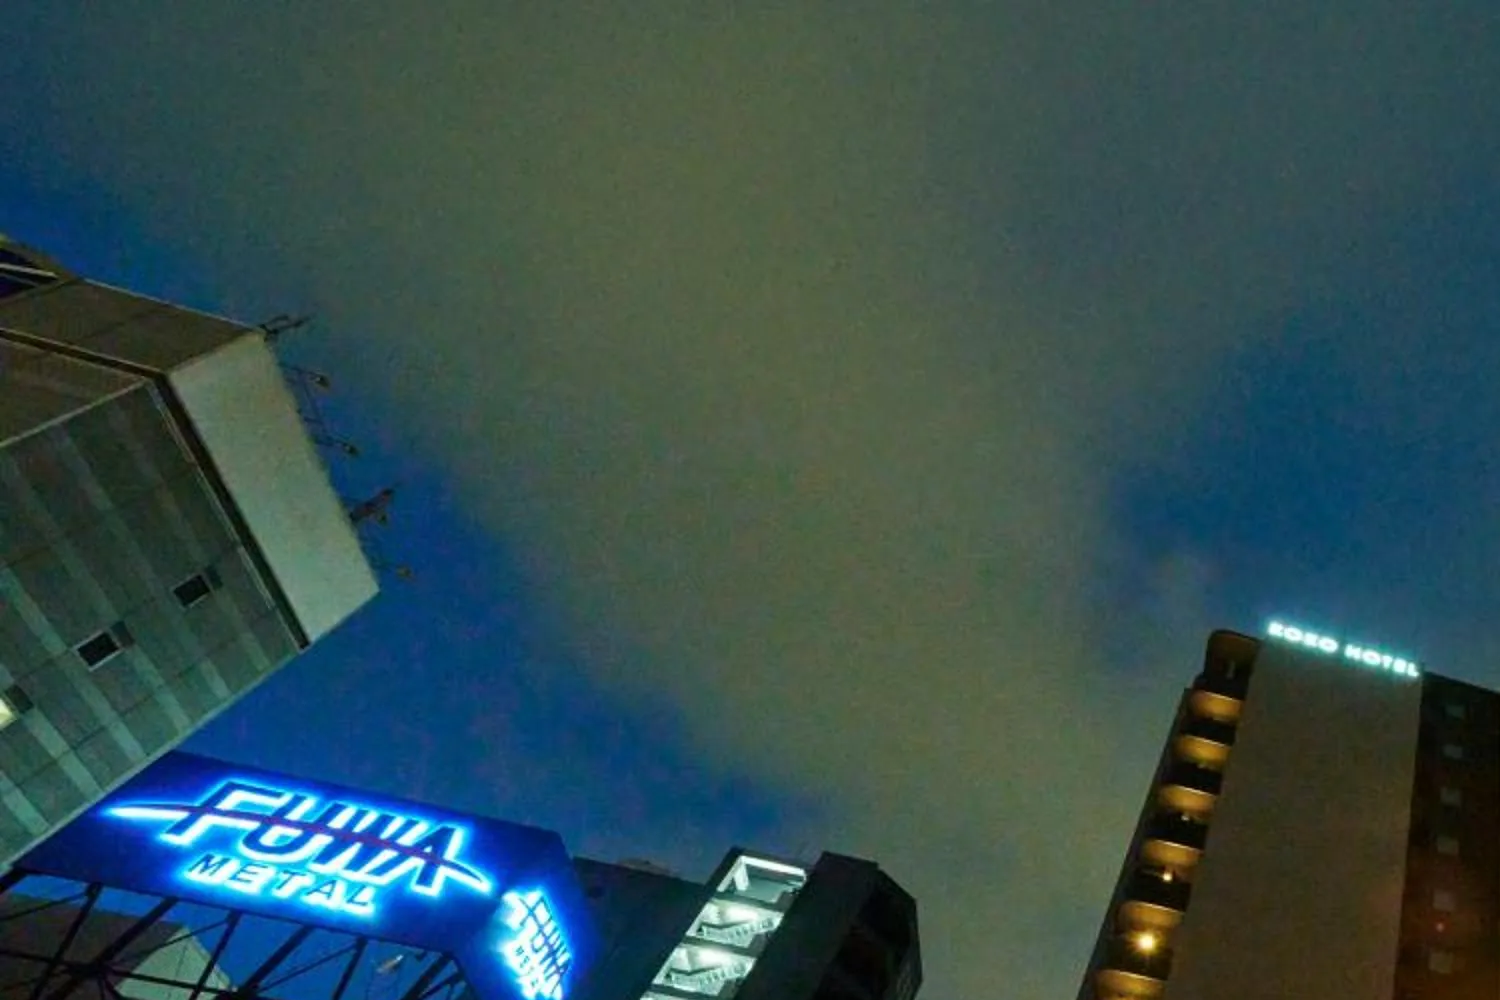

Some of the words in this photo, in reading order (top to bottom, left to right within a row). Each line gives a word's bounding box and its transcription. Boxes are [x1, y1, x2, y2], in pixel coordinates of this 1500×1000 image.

[1343, 643, 1419, 678] HOTEL
[158, 778, 468, 897] FUWA
[185, 852, 378, 915] METAL
